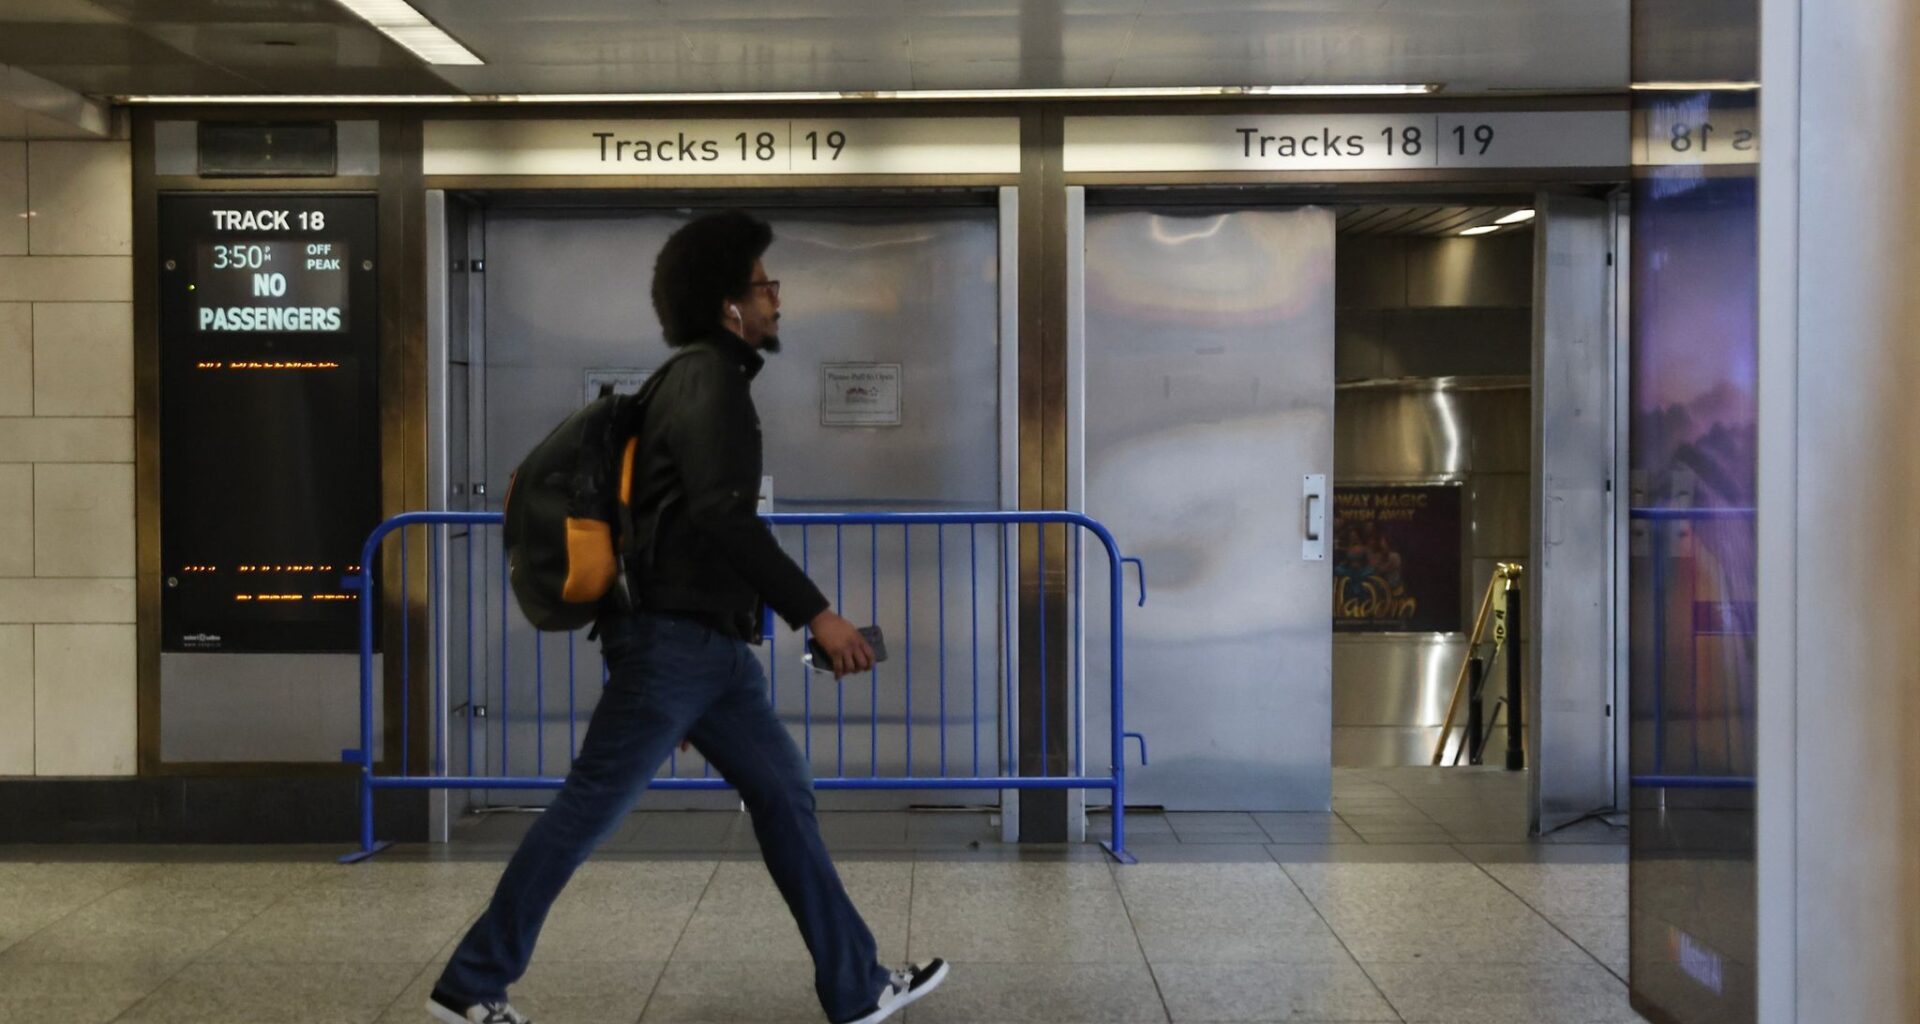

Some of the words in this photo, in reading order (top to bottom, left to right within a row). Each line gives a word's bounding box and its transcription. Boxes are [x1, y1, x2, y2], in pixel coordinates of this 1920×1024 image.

[592, 131, 719, 161] Tracks
[735, 131, 775, 161] 18
[805, 130, 846, 161] 19
[1235, 127, 1364, 157] Tracks
[1381, 126, 1421, 156] 18
[1453, 124, 1494, 156] 19
[212, 210, 290, 231] TRACK
[298, 211, 325, 231] 18
[213, 245, 263, 269] 3:50
[306, 244, 332, 256] OFF
[306, 258, 340, 270] PEAK
[253, 272, 286, 297] NO
[199, 307, 341, 331] PASSENGERS
[1375, 493, 1428, 508] MAGIC
